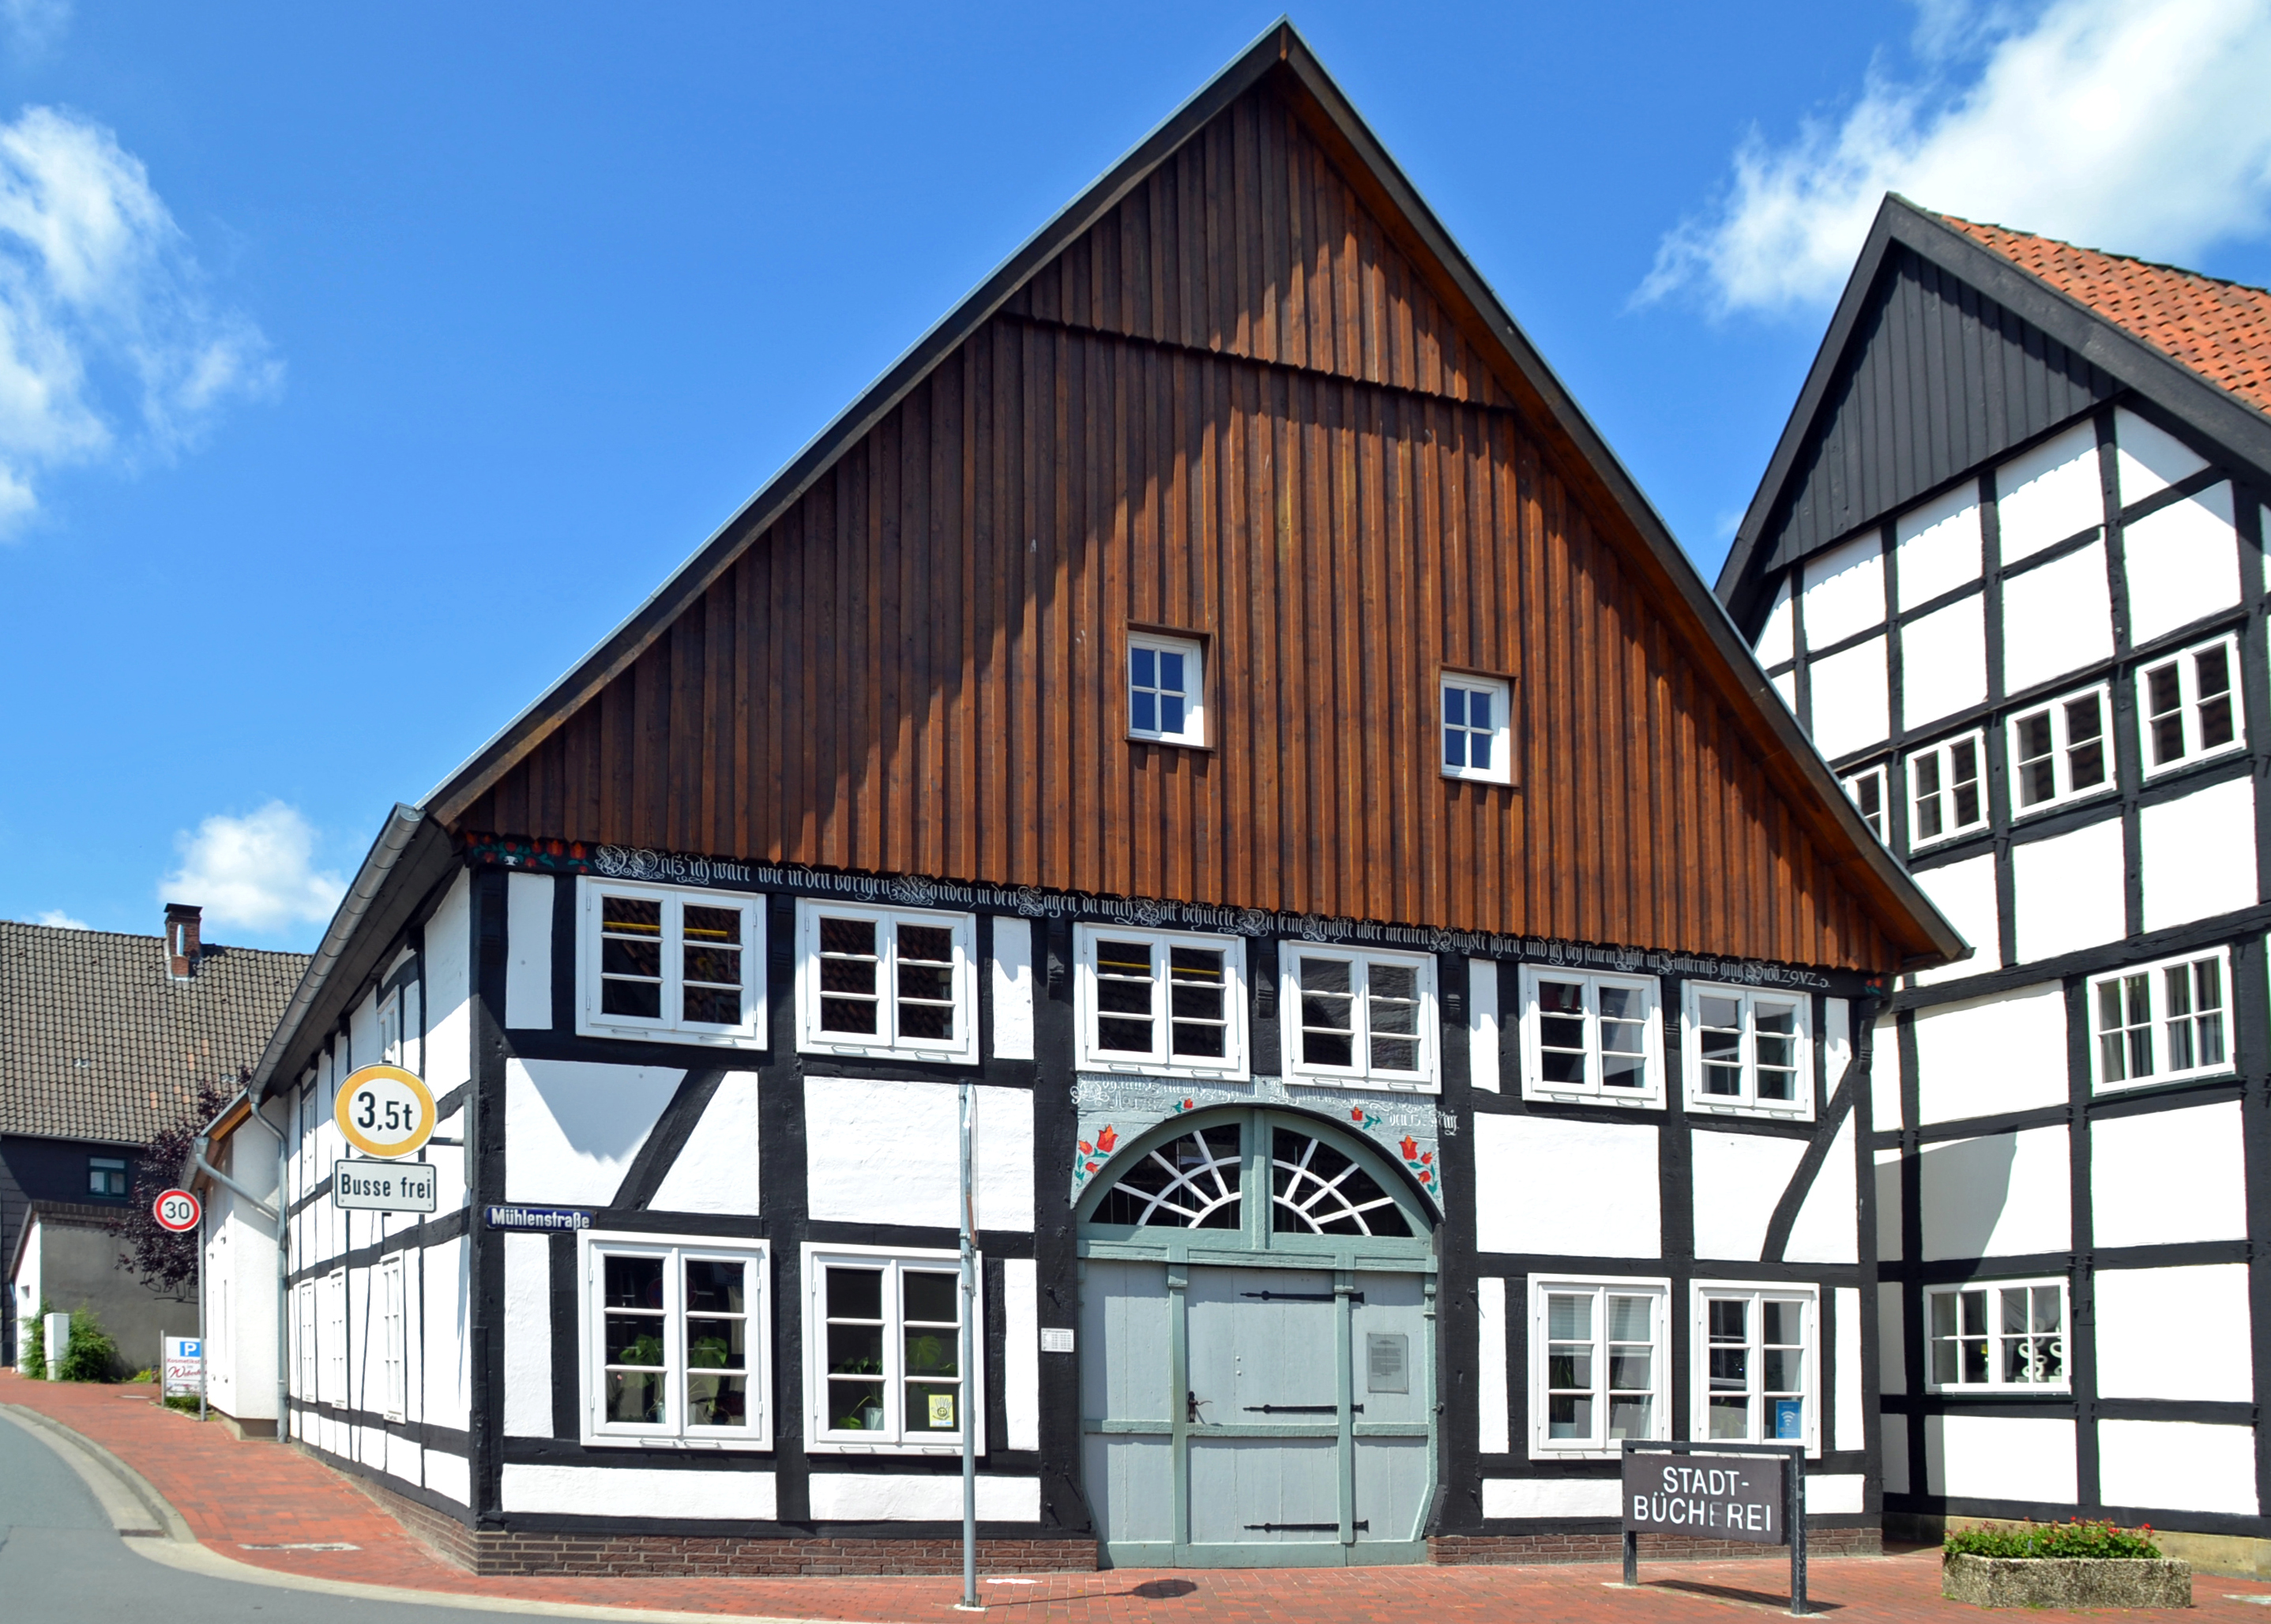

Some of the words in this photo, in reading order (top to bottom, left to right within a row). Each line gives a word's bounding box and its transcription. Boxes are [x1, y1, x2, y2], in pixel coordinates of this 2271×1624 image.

[758, 863, 783, 885] wie
[788, 865, 803, 886] in
[800, 865, 831, 889] den
[833, 874, 893, 900] vorigen
[977, 883, 991, 905] in
[991, 883, 1018, 906] den
[1079, 893, 1098, 914] da
[357, 1091, 413, 1132] 3,5t
[340, 1173, 391, 1197] Busse
[400, 1176, 431, 1199] frei
[164, 1201, 190, 1220] 30
[491, 1207, 590, 1231] Mühlenstraße
[1663, 1465, 1750, 1496] STADT-
[1634, 1491, 1771, 1532] BÜCHEREI
